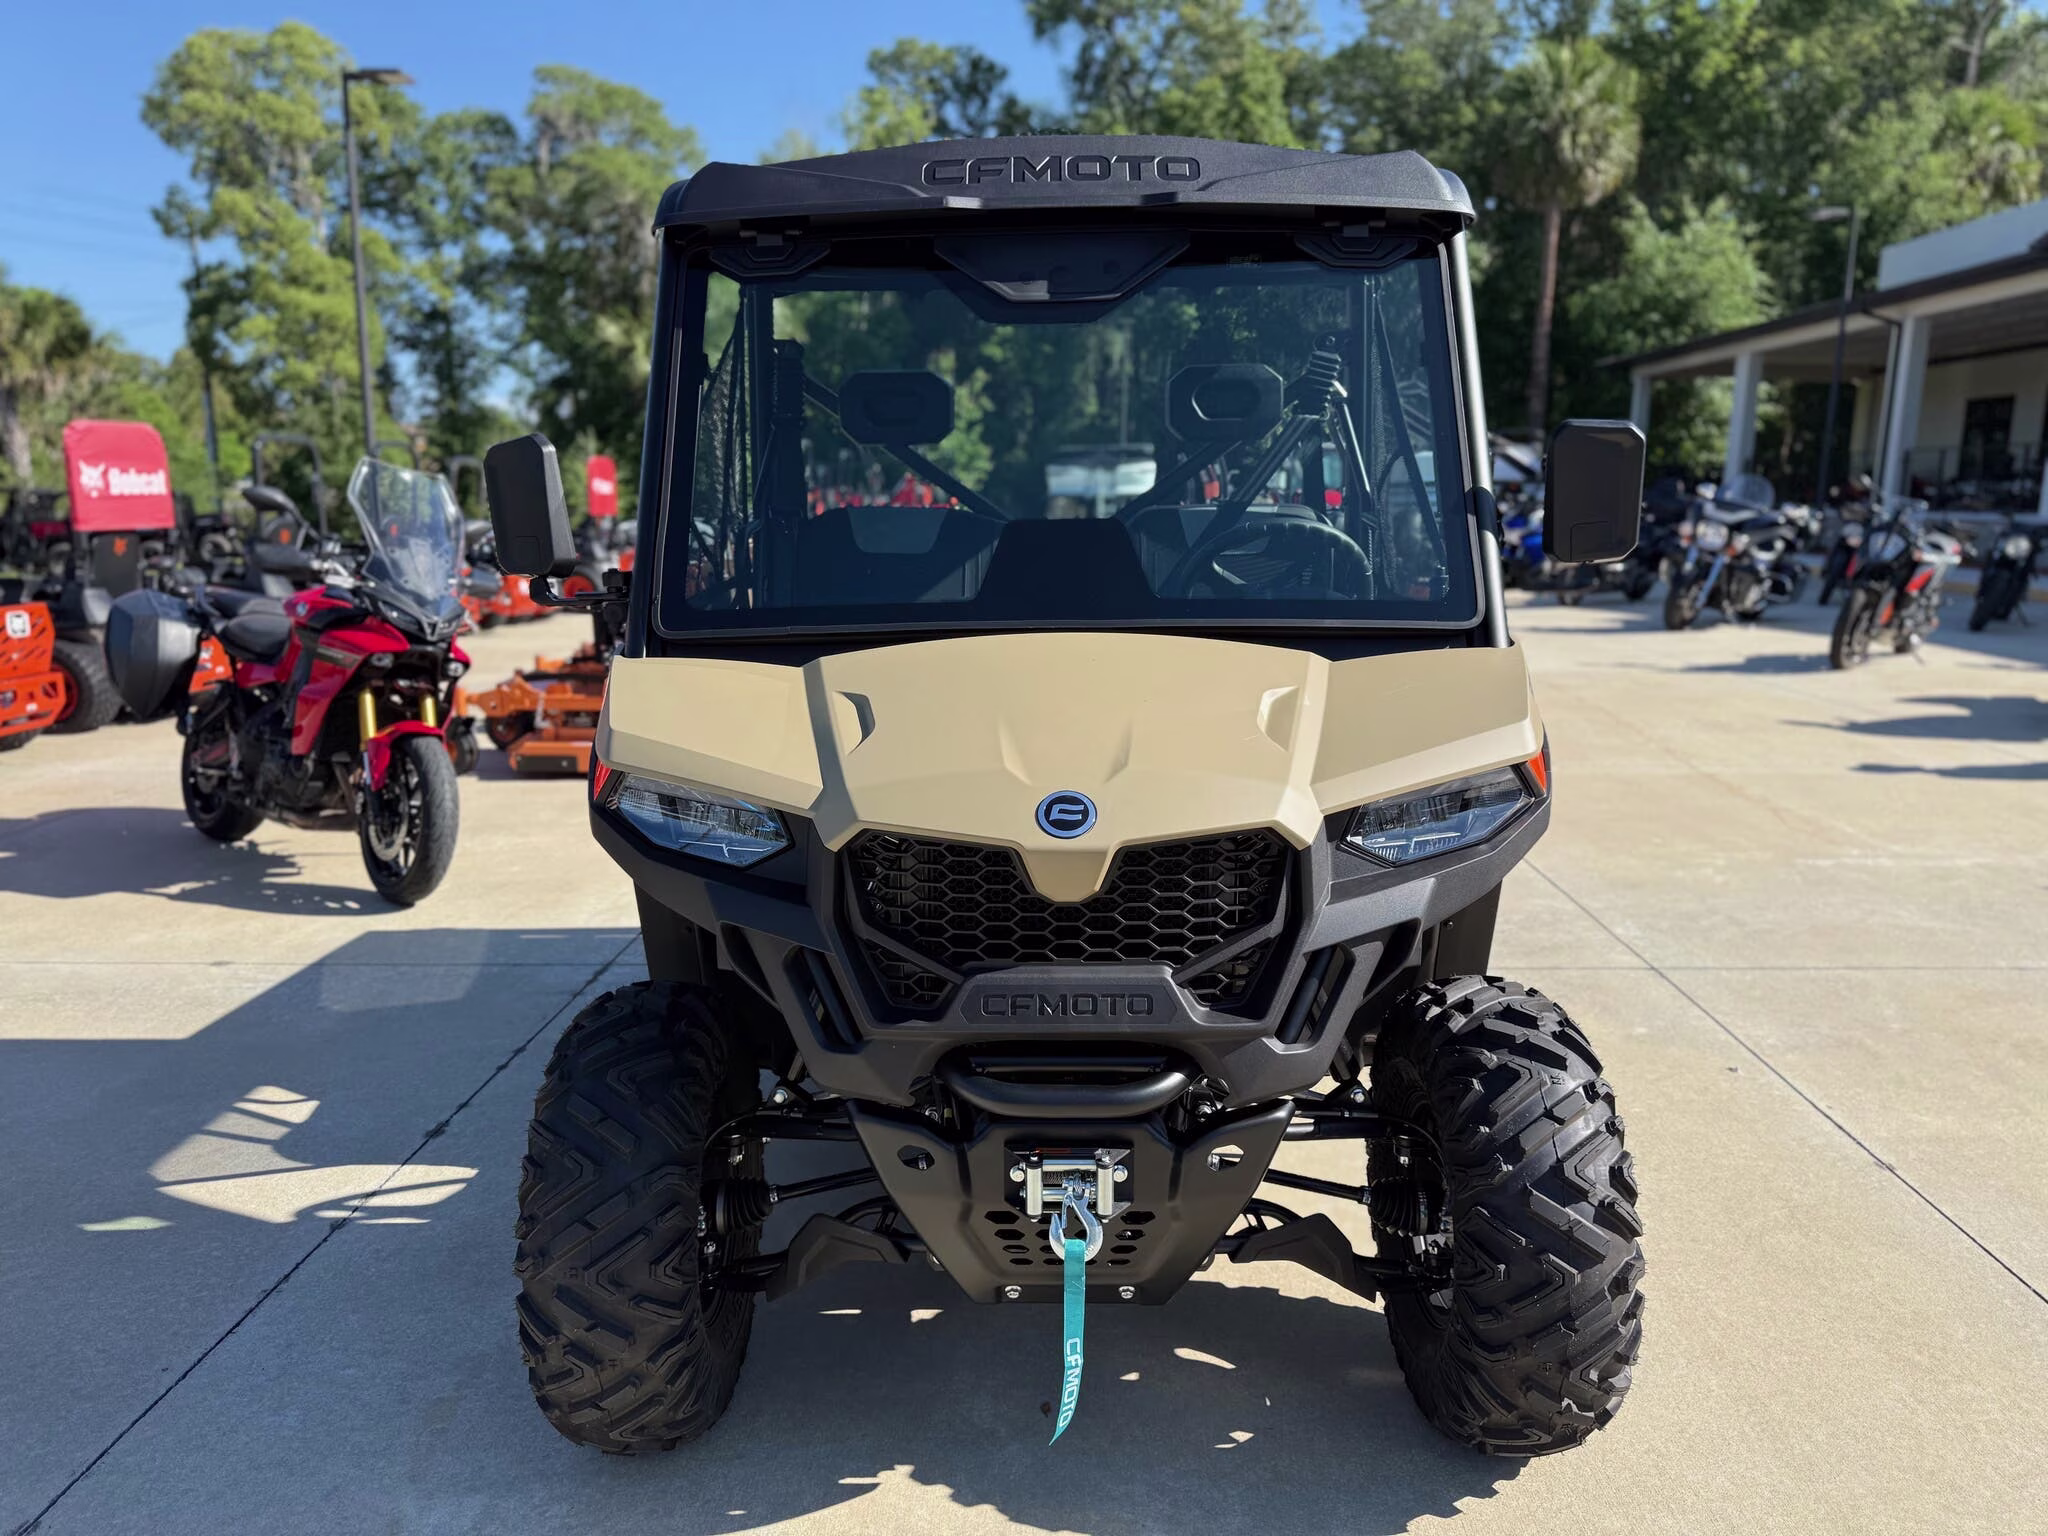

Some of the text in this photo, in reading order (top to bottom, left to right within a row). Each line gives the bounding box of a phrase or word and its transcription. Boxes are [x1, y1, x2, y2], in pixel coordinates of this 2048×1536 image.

[921, 155, 1200, 185] CFMOTO
[981, 993, 1154, 1017] CFMOTO
[1060, 1338, 1081, 1428] CFMOTO
